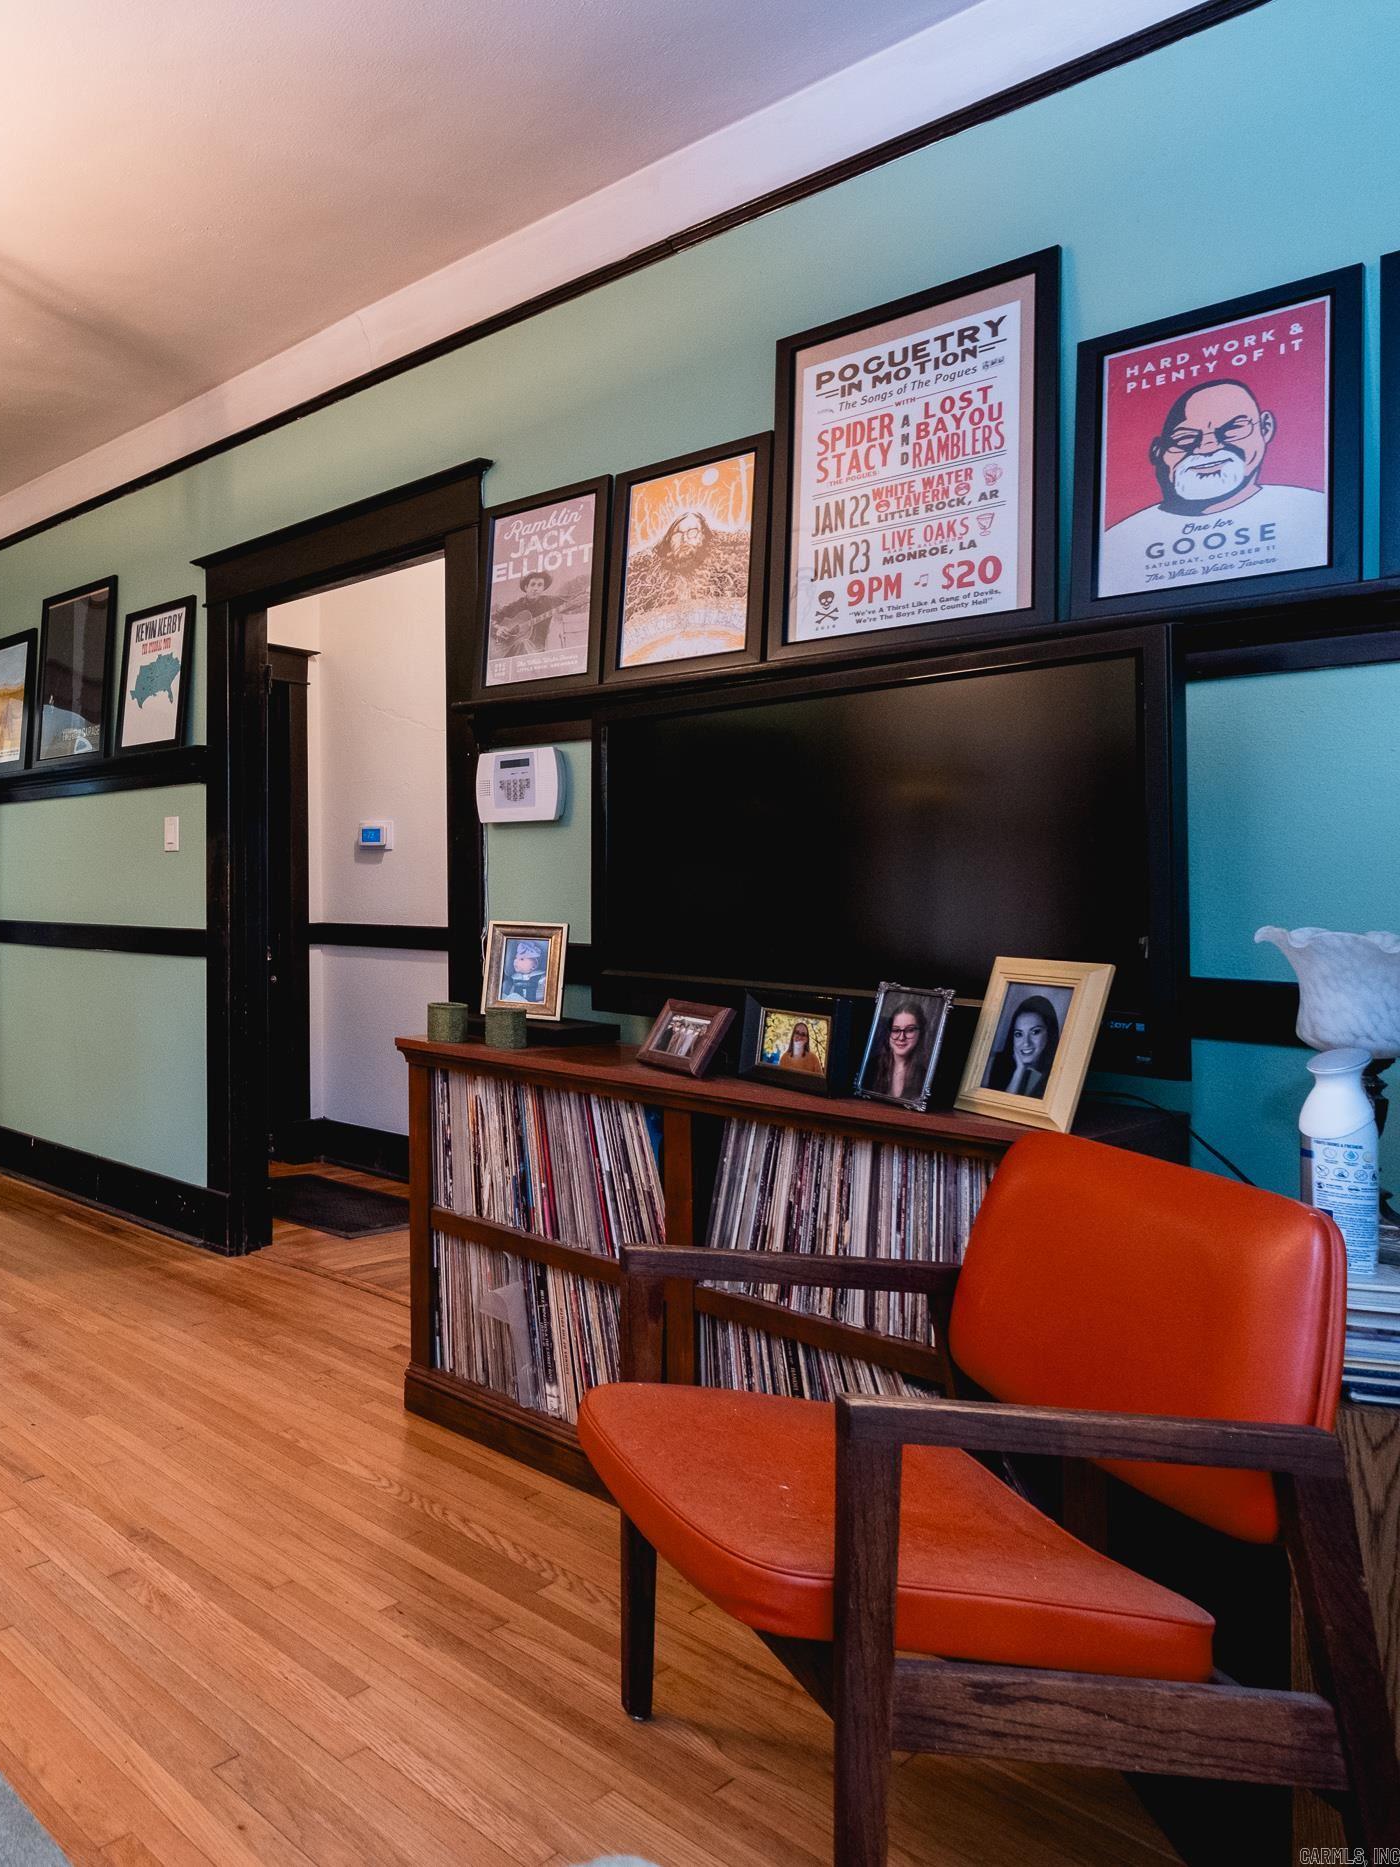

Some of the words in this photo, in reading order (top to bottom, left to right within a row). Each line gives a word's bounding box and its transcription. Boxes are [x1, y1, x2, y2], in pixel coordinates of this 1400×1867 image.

[815, 314, 1008, 391] POGUETRY
[1126, 352, 1191, 378] HARD
[1202, 329, 1276, 356] WORK
[1289, 323, 1304, 335] &
[1126, 360, 1219, 393] PLENTY
[1231, 349, 1265, 367] OF
[1279, 338, 1304, 355] IT
[838, 399, 857, 412] The
[859, 390, 893, 406] Songs
[896, 383, 908, 395] of
[910, 379, 931, 392] The
[934, 364, 978, 385] Pogues
[840, 379, 863, 398] IN
[871, 345, 979, 389] MOTION
[894, 396, 916, 408] WITH
[923, 384, 994, 419] LOST
[816, 412, 894, 456] SPIDER
[916, 401, 1004, 440] BAYOU
[816, 439, 893, 483] STACY
[912, 421, 1005, 468] RAMBLERS
[871, 479, 916, 502] WHITE
[921, 467, 974, 490] WATER
[894, 485, 950, 510] TAVERN
[503, 504, 584, 540] Ramblin'
[811, 498, 846, 537] JAN
[849, 493, 870, 528] 22
[877, 506, 920, 523] LITTLE
[924, 496, 972, 513] ROCK,
[977, 489, 1000, 502] AR
[510, 525, 577, 559] JACK
[881, 527, 916, 552] LIVE
[923, 516, 970, 542] OAKS
[1145, 523, 1277, 559] GOOSE
[1182, 522, 1211, 535] One
[1213, 518, 1235, 529] for
[492, 542, 594, 583] ELLIOTT
[810, 543, 845, 582] JAN
[849, 538, 871, 574] 23
[882, 545, 953, 566] MONROE,
[959, 539, 978, 551] LA
[1145, 574, 1166, 583] The
[1167, 568, 1199, 580] White
[1201, 563, 1235, 576] Water
[1238, 557, 1279, 569] Tavern
[1208, 546, 1261, 560] OCTOBER
[846, 572, 903, 607] 9PM
[941, 555, 1003, 590] $20
[879, 613, 894, 621] The
[895, 610, 916, 620] Boys
[917, 606, 939, 615] From
[940, 602, 969, 612] County
[887, 602, 910, 612] Thirst
[911, 599, 928, 608] Like
[938, 595, 960, 604] Gang
[157, 612, 184, 637] KERBY
